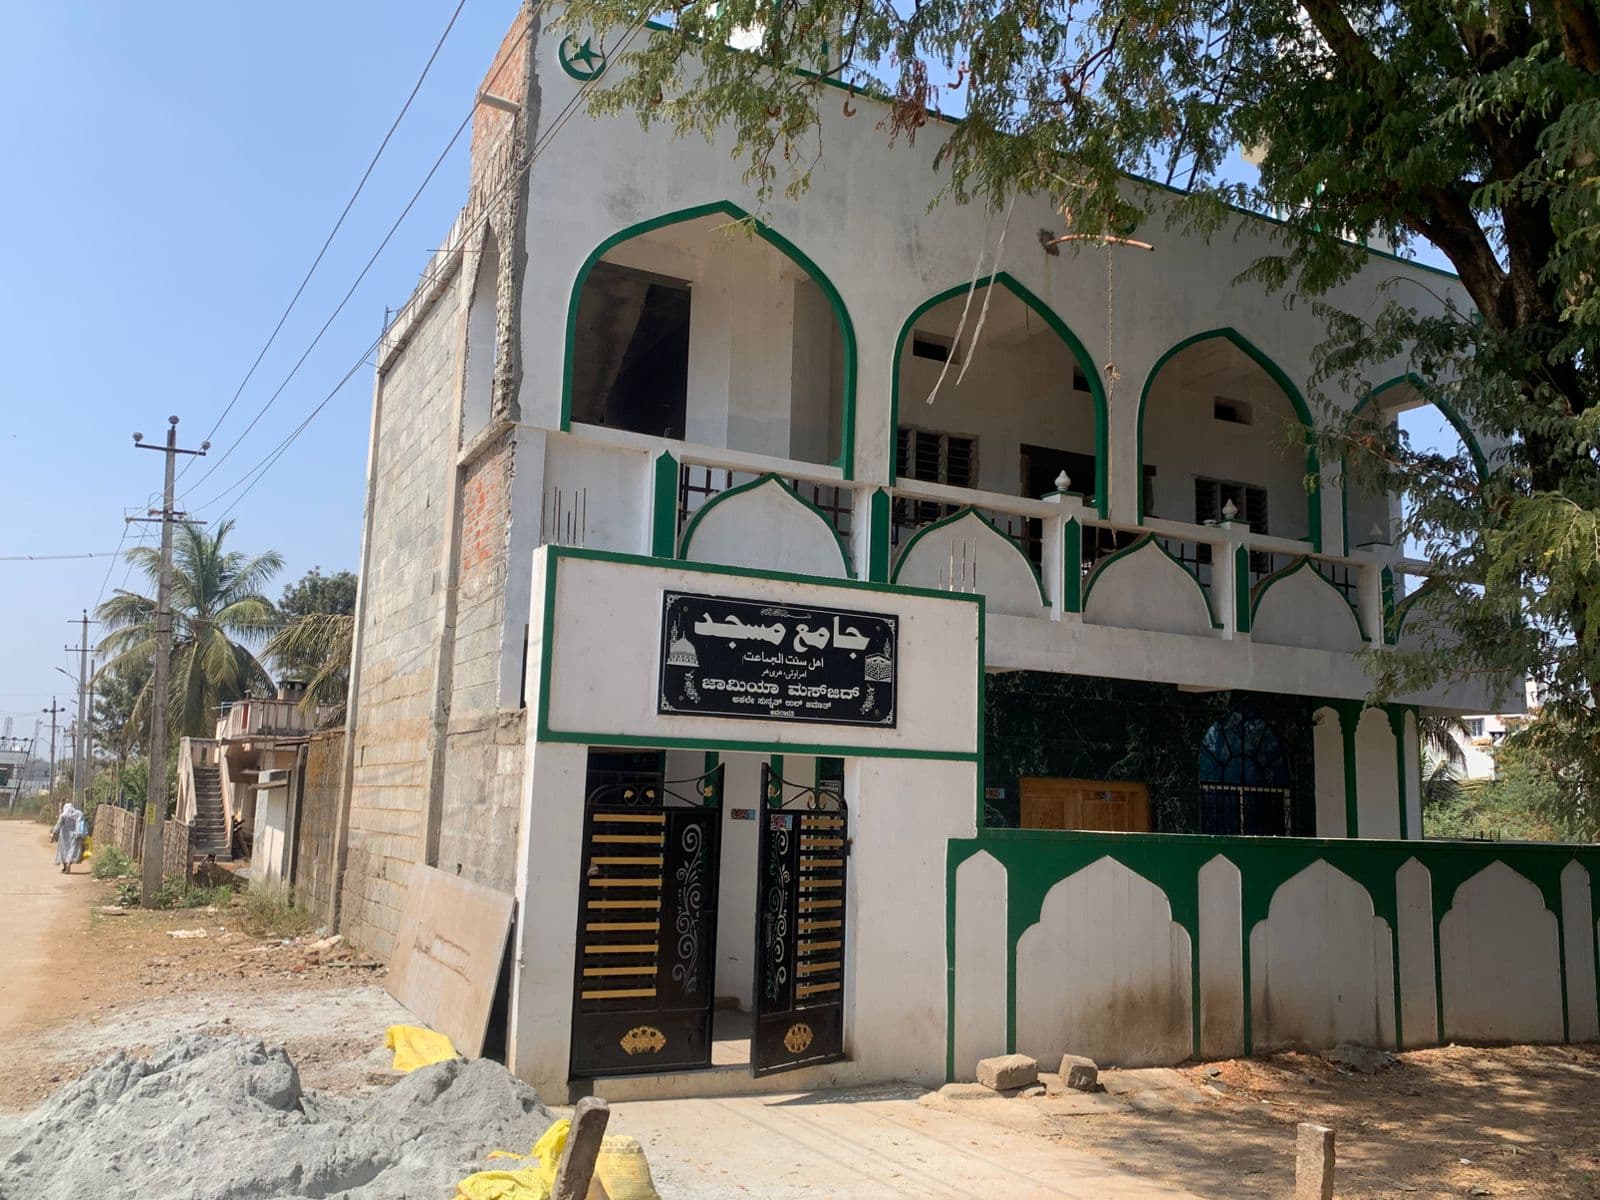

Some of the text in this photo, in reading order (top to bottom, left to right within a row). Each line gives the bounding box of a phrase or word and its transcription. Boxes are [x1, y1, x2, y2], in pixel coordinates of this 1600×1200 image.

[694, 612, 871, 660] جامع مسجد
[785, 655, 807, 666] سنت
[702, 677, 780, 694] ಜಾಮಿಯಾ
